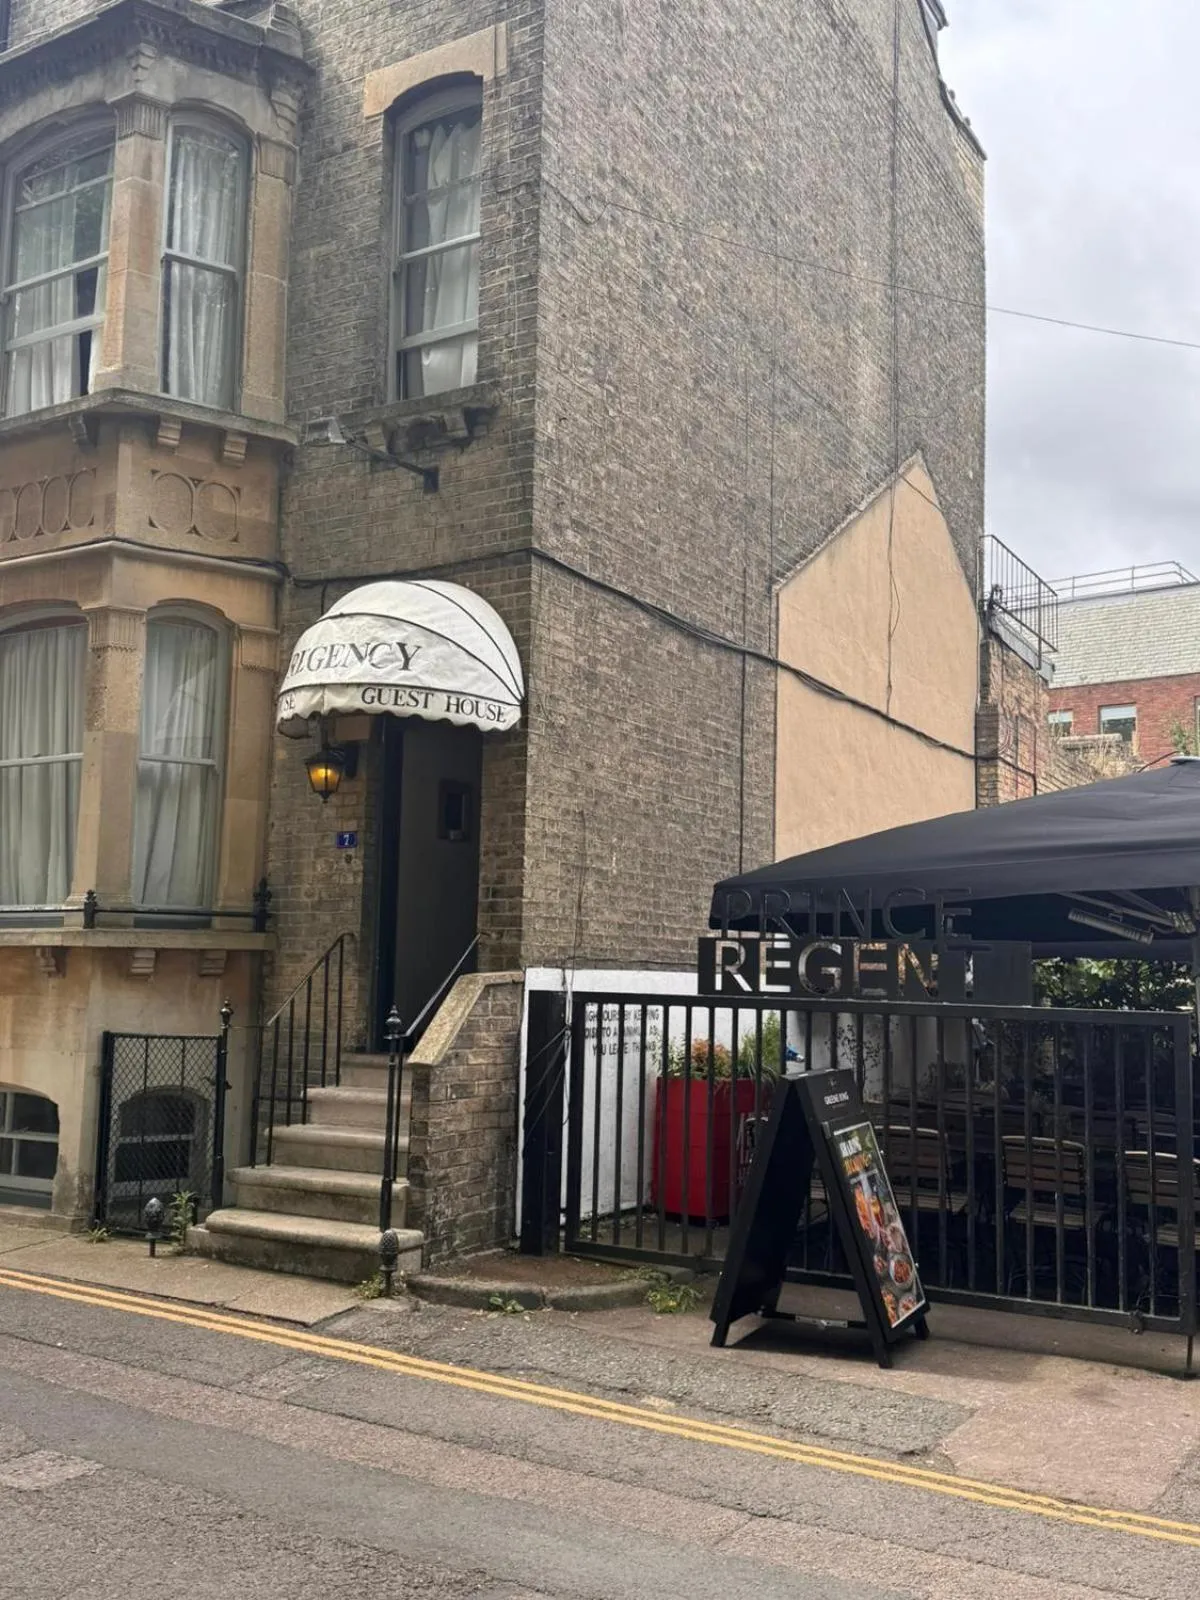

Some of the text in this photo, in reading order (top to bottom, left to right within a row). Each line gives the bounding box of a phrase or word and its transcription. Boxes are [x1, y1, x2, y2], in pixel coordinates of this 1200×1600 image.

[361, 686, 507, 723] GUEST HOUSE
[343, 834, 350, 846] 7
[722, 887, 973, 939] PRINCE
[714, 939, 992, 998] REGENT
